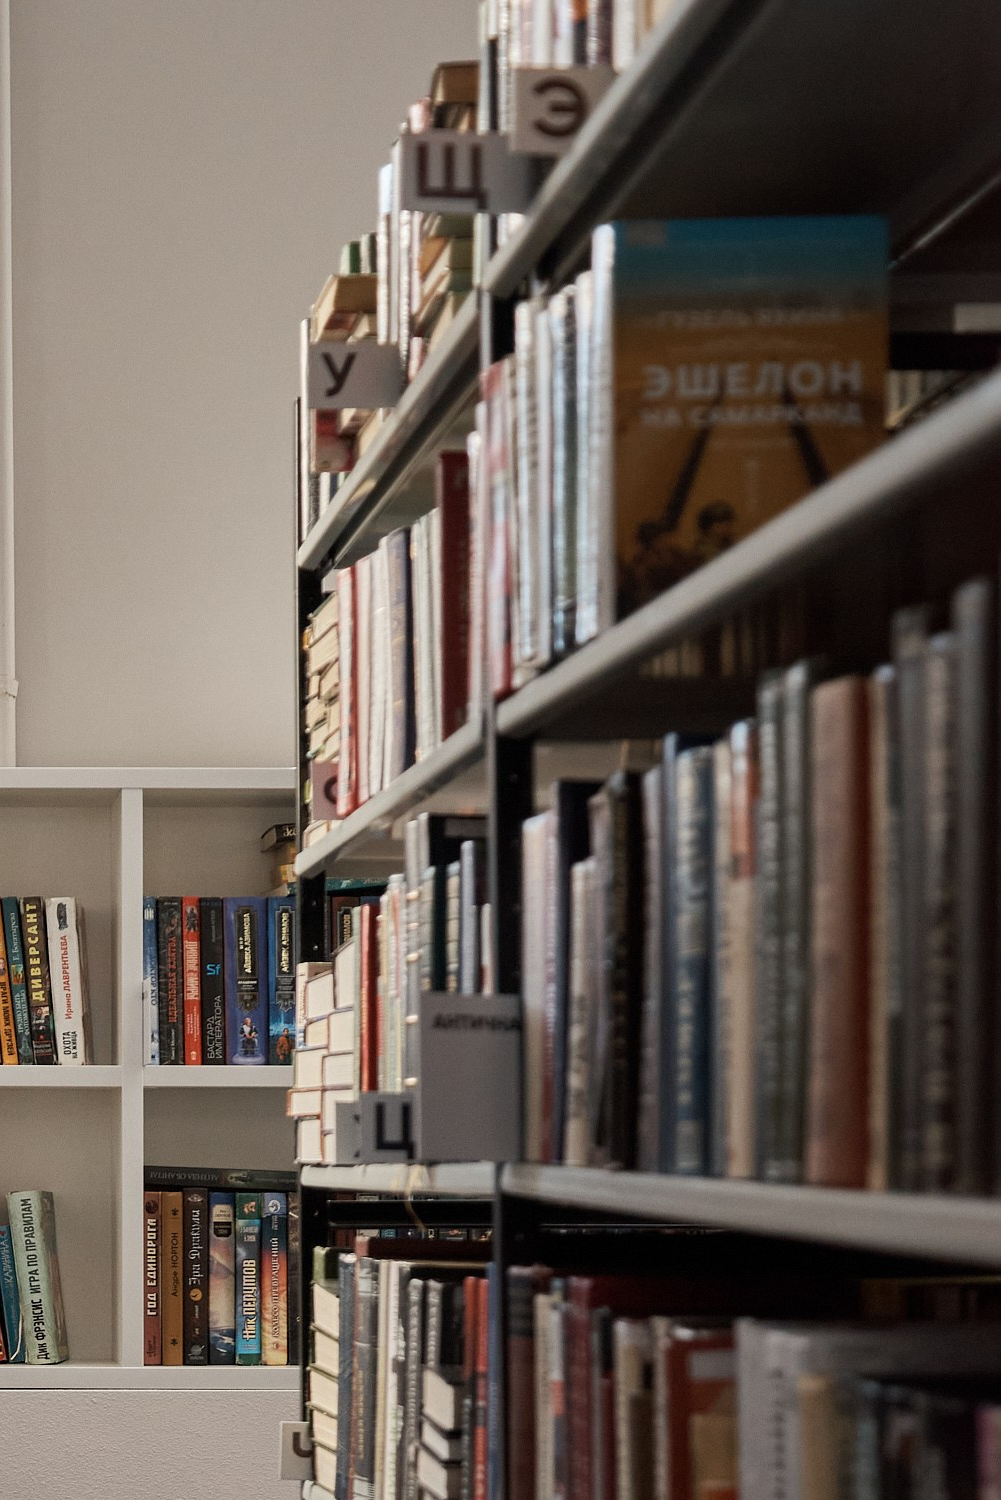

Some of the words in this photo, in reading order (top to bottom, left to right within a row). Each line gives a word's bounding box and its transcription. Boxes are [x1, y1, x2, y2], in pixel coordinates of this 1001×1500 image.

[532, 75, 585, 138] Э
[320, 350, 357, 397] У
[640, 359, 864, 402] ЭШЕЛОН
[243, 912, 251, 946] АЗИМОВА
[281, 912, 290, 946] АЗИМОВ
[25, 903, 46, 1002] ДИВЕРСАНТ
[59, 934, 71, 992] ЛАВРЕНТЬЕВА
[243, 947, 252, 973] АЙЗЕКА
[280, 946, 289, 973] АЙЗЕК
[64, 992, 74, 1020] Ирина
[214, 995, 223, 1059] ИМПЕРАТОРА
[62, 1031, 72, 1055] ОХОТА
[207, 1016, 215, 1059] БАСТАРД
[376, 1102, 415, 1160] Ц
[21, 1197, 36, 1248] ПРАВИЛАМ
[0, 1239, 13, 1284] КАЛИНИНА
[26, 1250, 38, 1267] ПО
[146, 1218, 157, 1288] ЕДИНОРОГА
[269, 1236, 280, 1303] ПРЕВРАЩЕНИЙ
[29, 1269, 42, 1296] ИГРА
[171, 1270, 179, 1298] Андре
[242, 1258, 258, 1315] ПЕРУМОВ
[32, 1298, 47, 1341] ФРЭНСИС
[146, 1295, 157, 1317] ГОД
[36, 1342, 50, 1361] Дик
